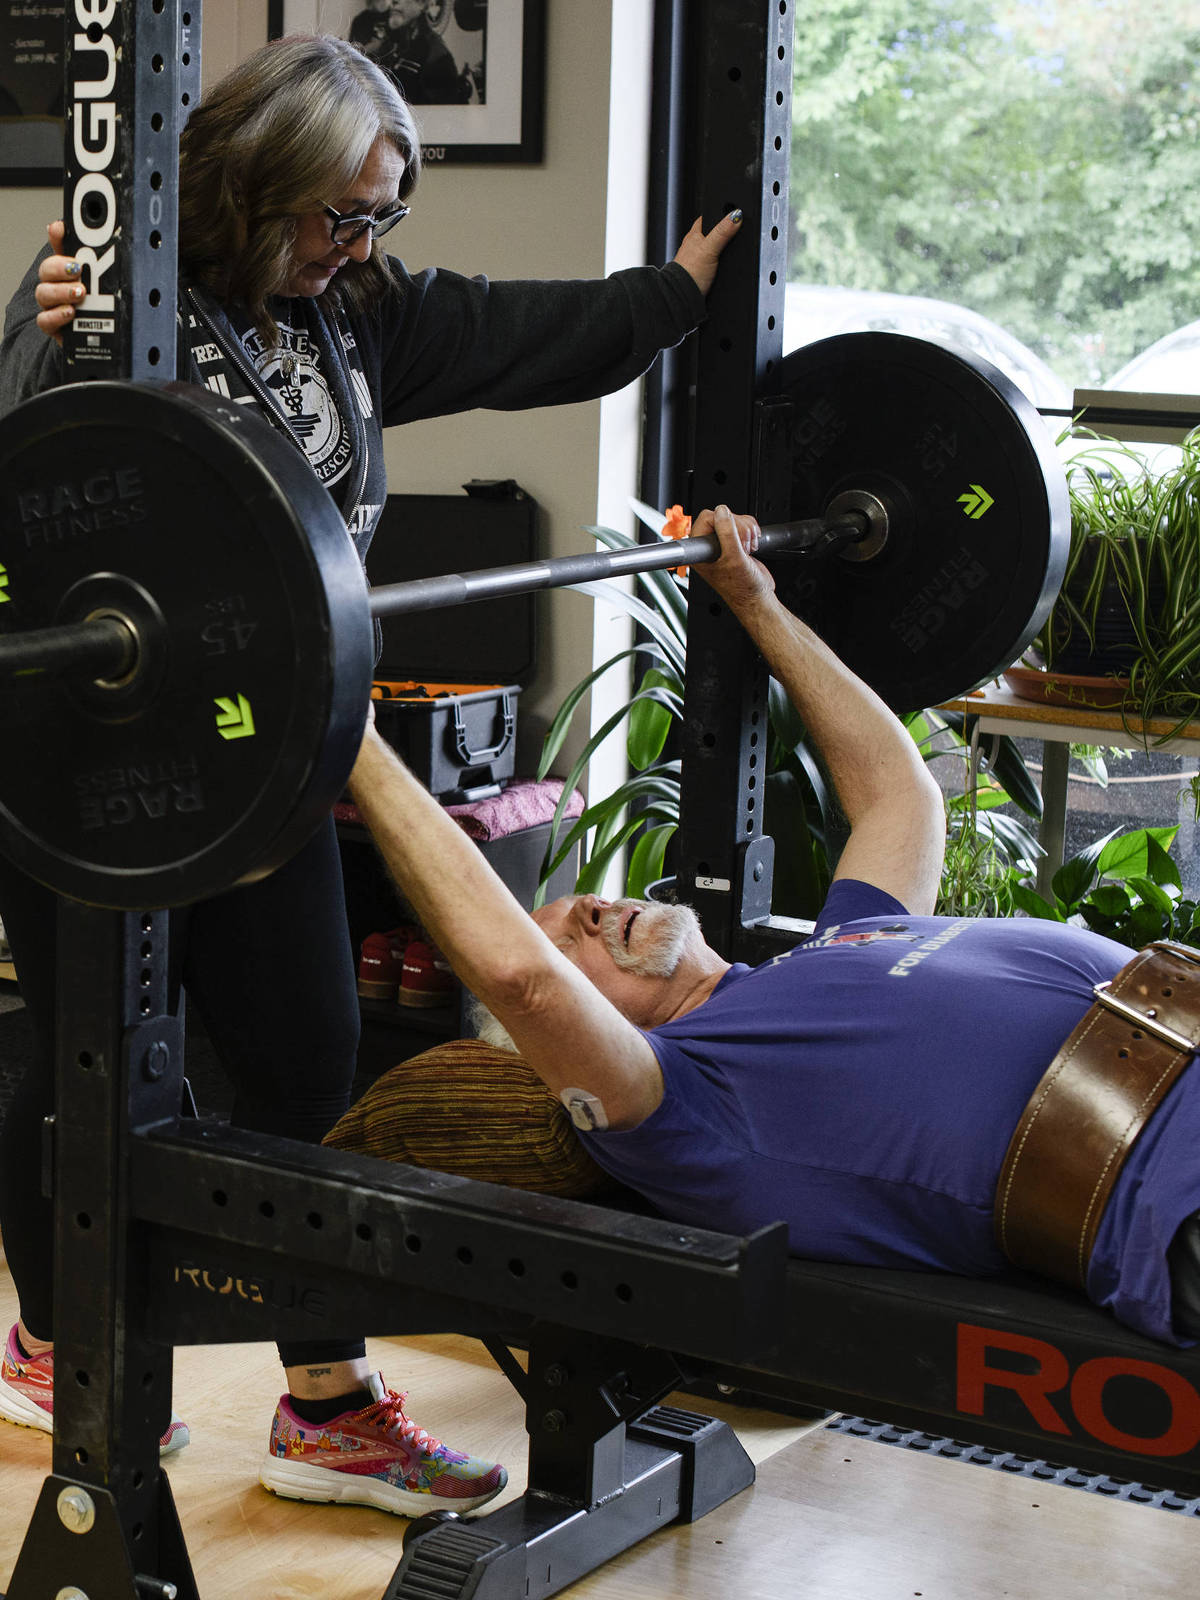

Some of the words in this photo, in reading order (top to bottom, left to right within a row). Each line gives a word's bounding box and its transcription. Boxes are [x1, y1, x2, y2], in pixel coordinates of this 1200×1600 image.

[77, 320, 103, 330] MONSTER
[17, 466, 146, 523] RACE
[23, 501, 149, 549] FITNESS
[887, 951, 932, 977] FOR
[956, 1321, 1200, 1457] RO
